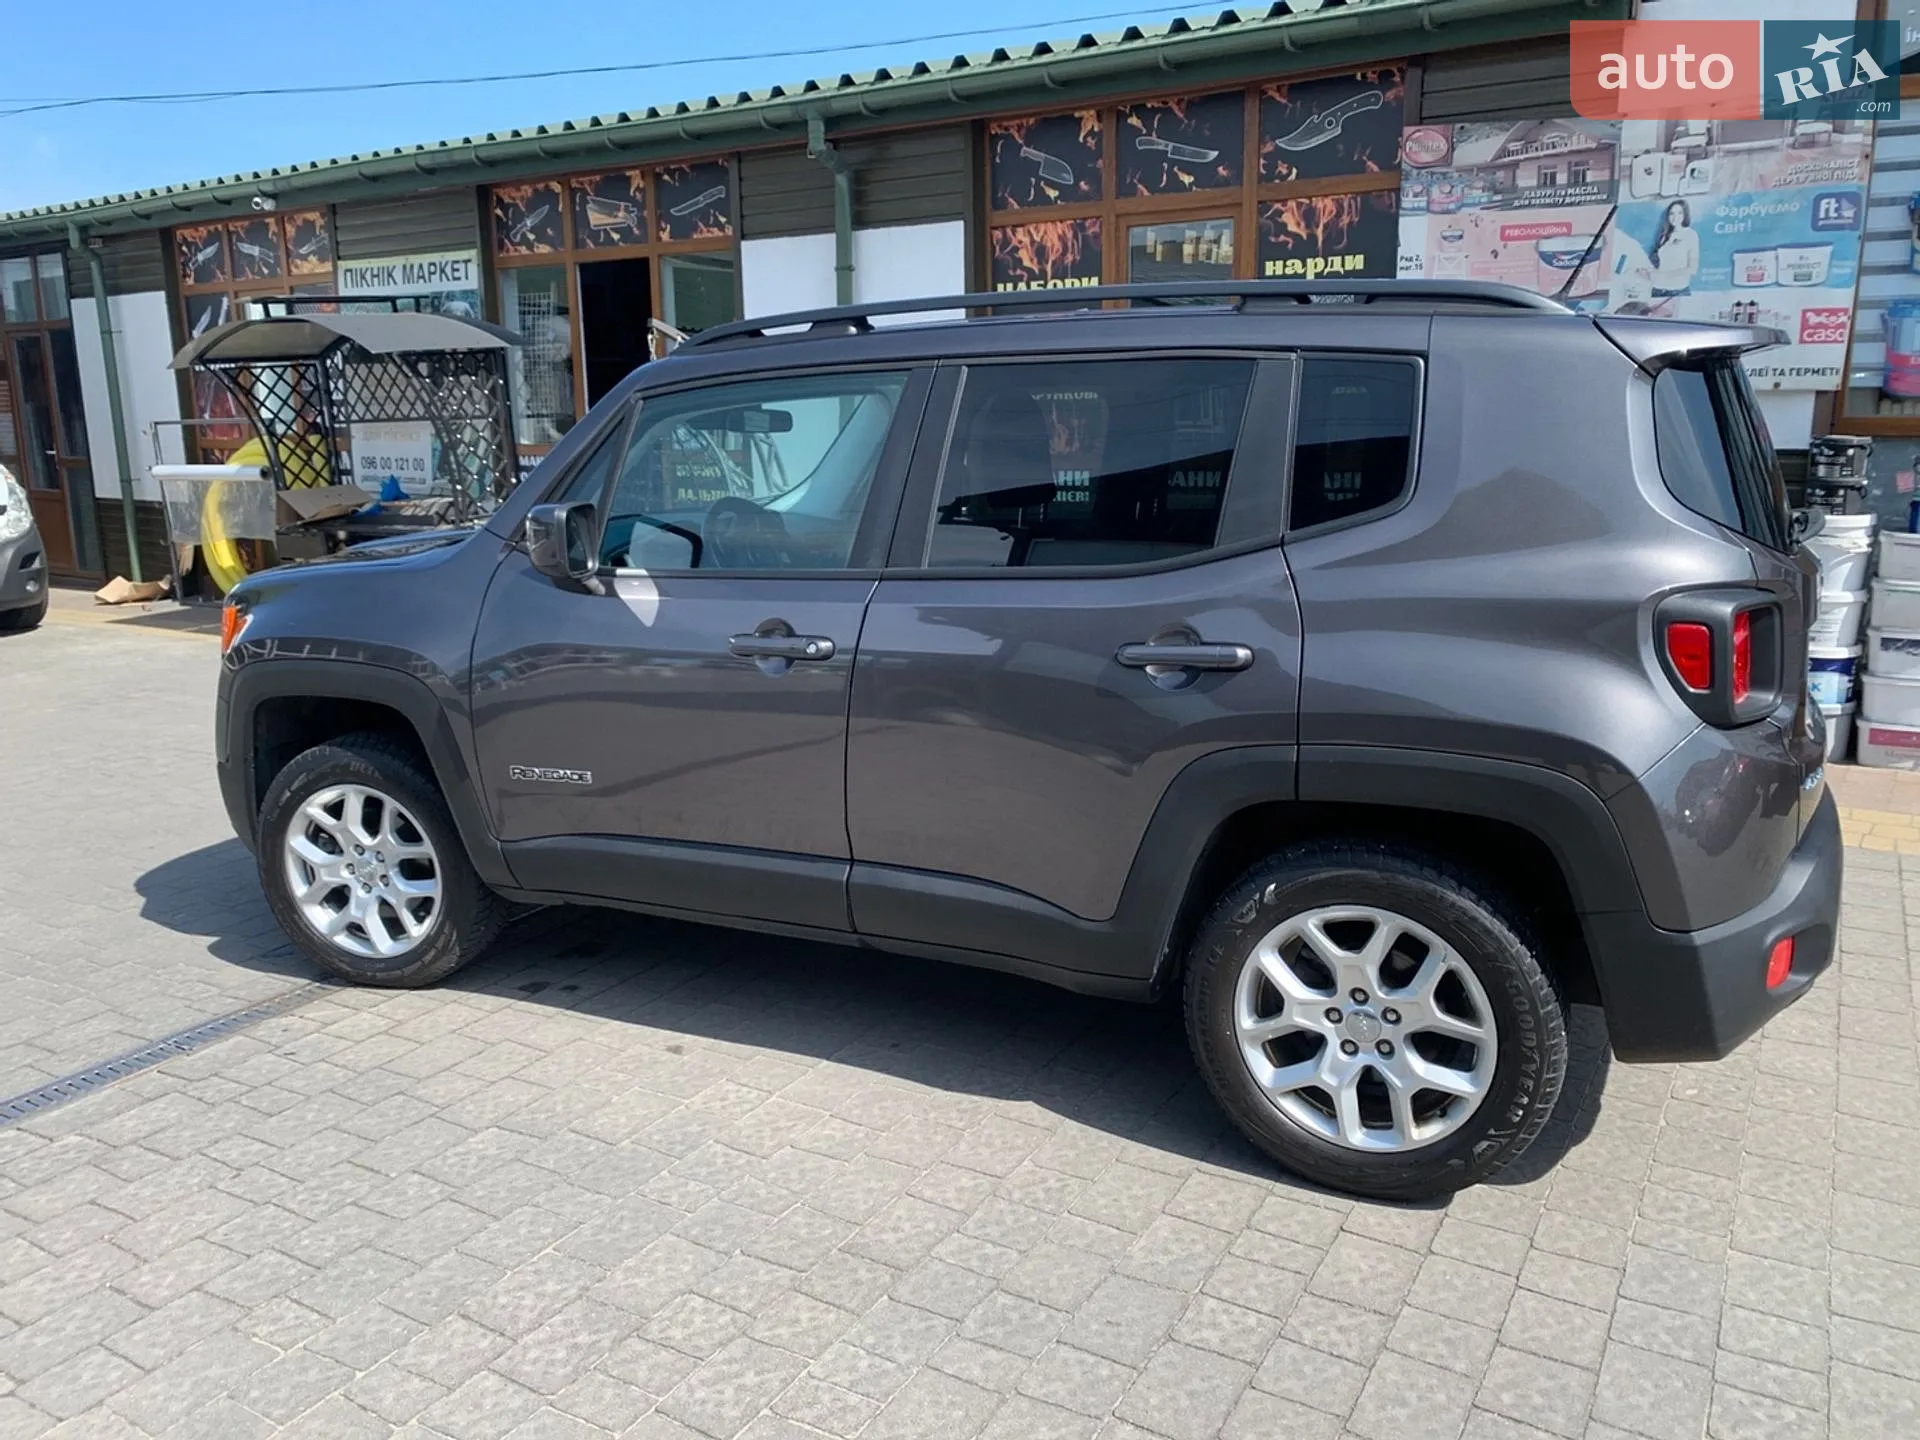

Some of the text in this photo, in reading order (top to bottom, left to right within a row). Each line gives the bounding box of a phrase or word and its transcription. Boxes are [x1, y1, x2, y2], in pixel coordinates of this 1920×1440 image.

[1715, 201, 1800, 218] Фарбуємо
[1714, 219, 1752, 234] Світ!
[344, 258, 472, 289] ПІКНІК МАРКЕТ
[1264, 254, 1364, 281] нарди
[1772, 367, 1786, 377] ТА
[360, 455, 378, 470] 096
[379, 455, 393, 470] 00
[394, 456, 410, 471] 121
[412, 457, 425, 472] 00
[509, 765, 593, 784] RENEGADE
